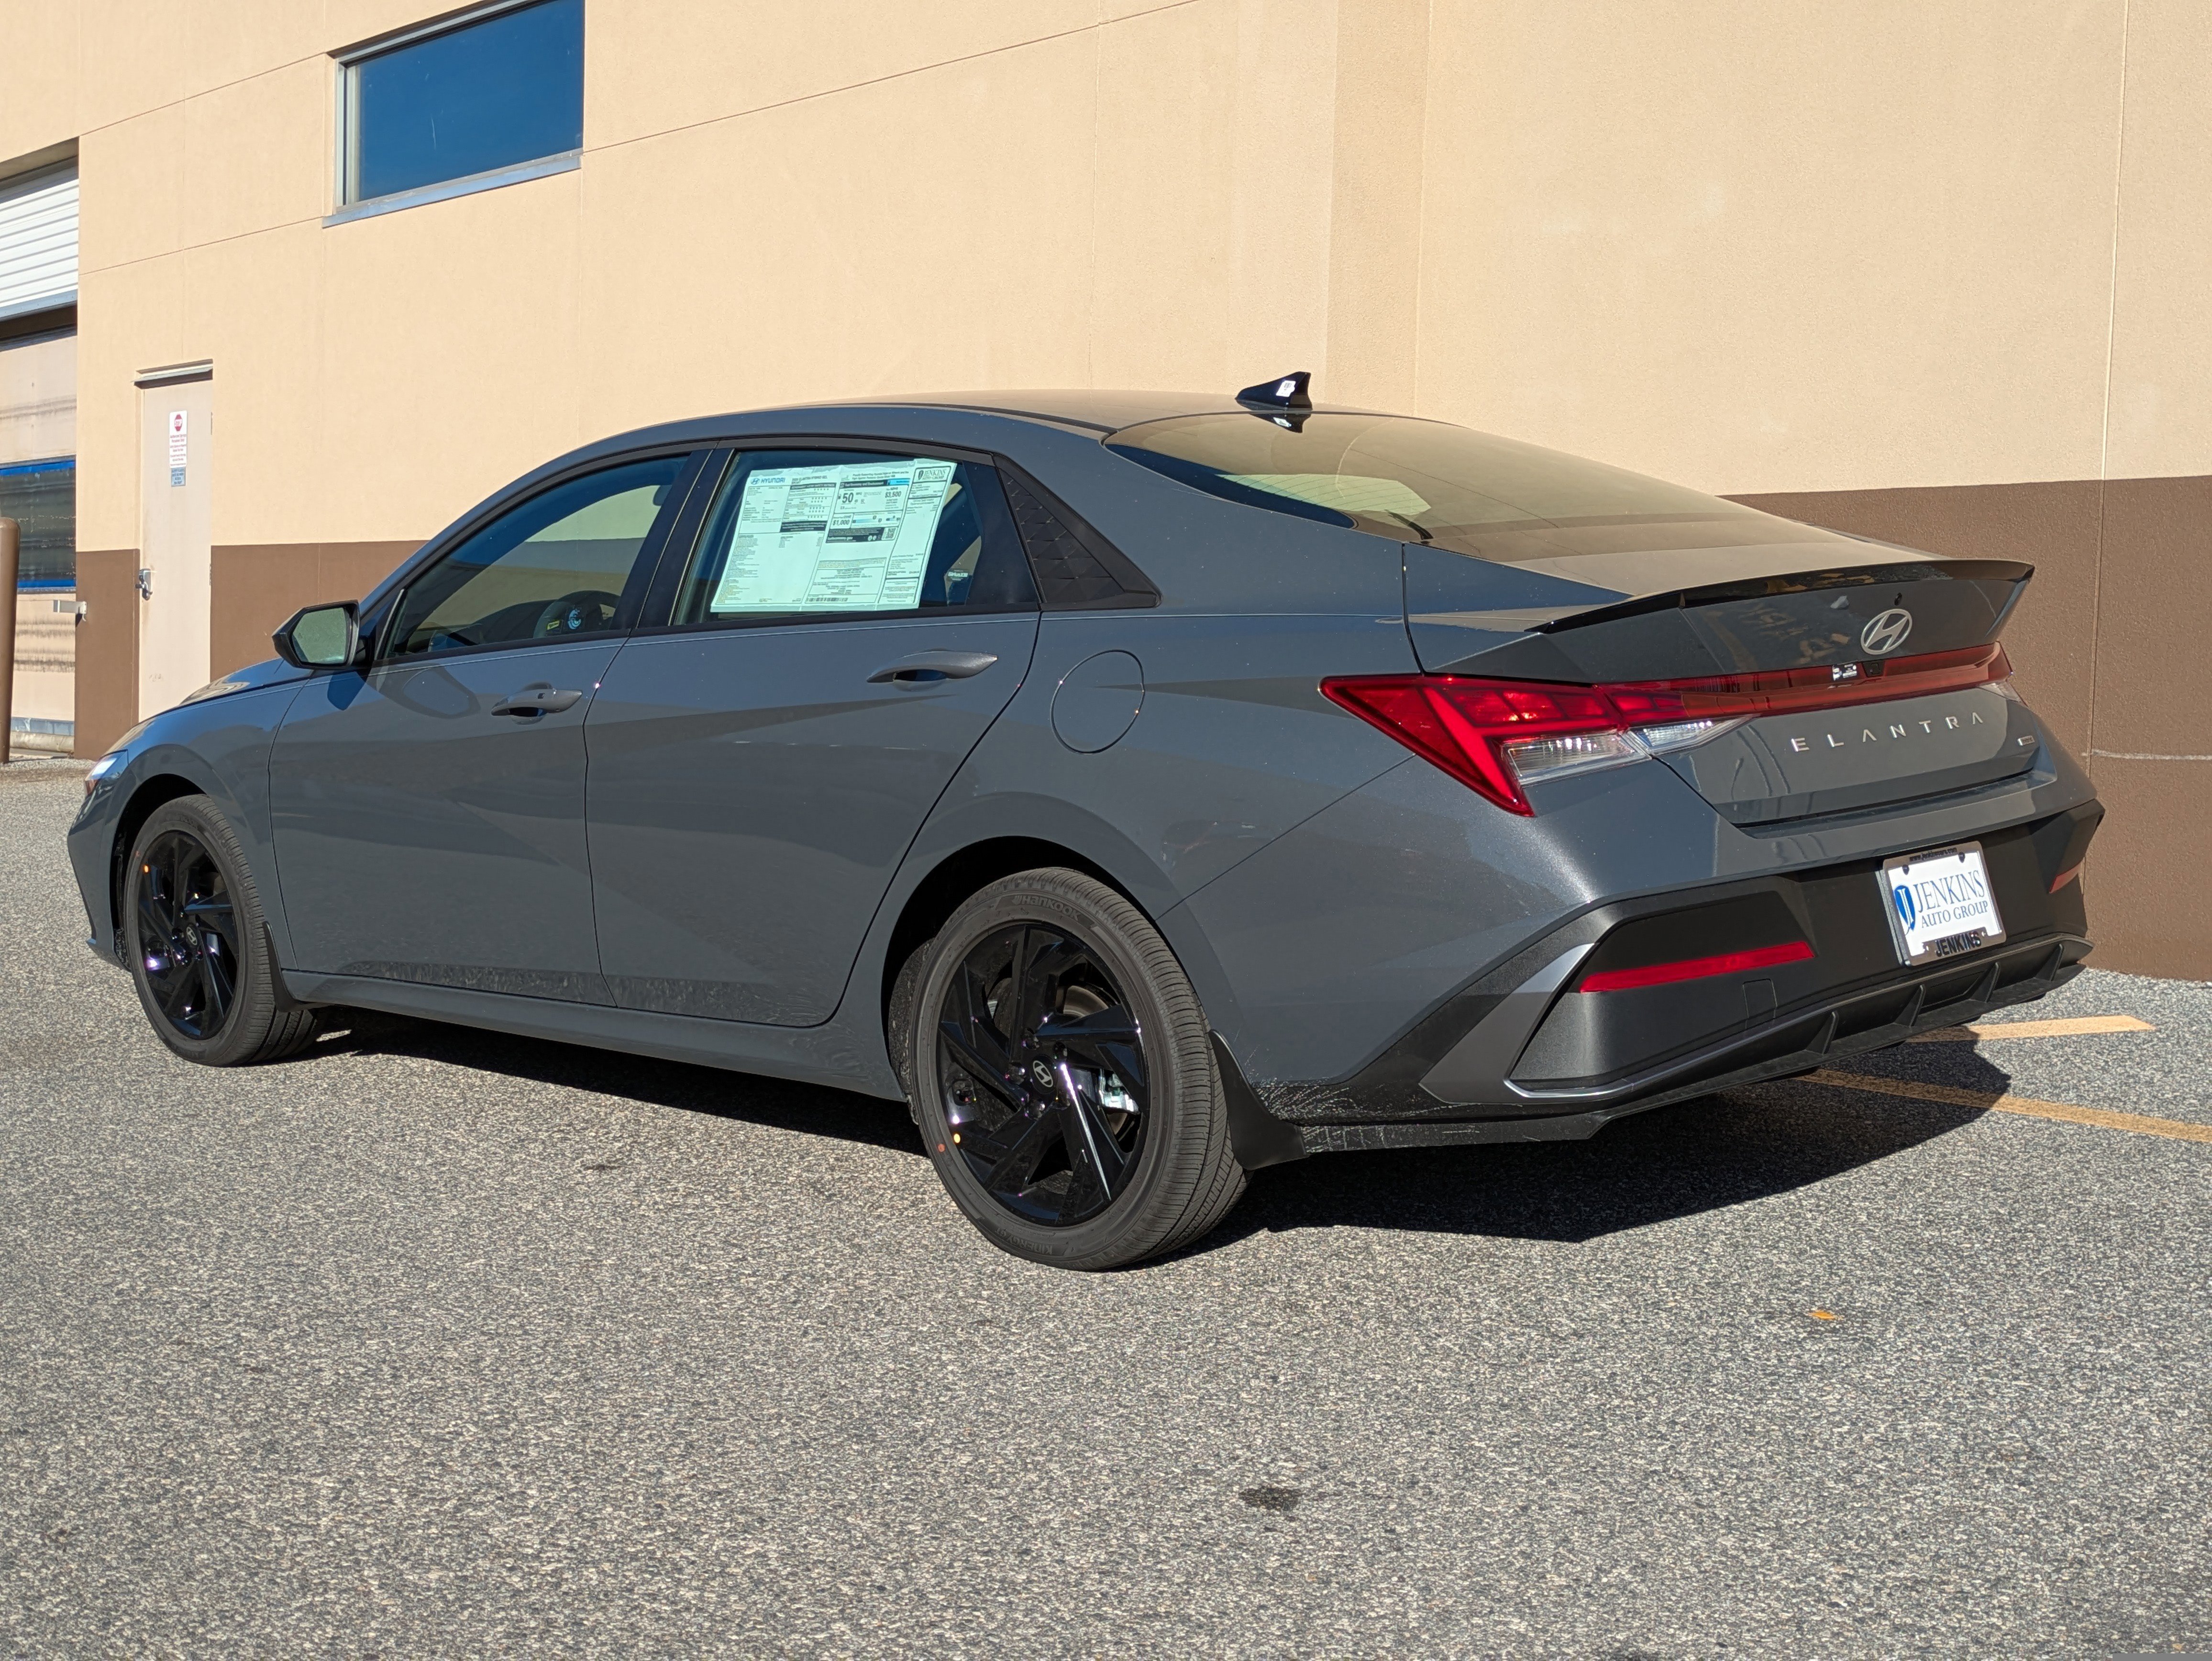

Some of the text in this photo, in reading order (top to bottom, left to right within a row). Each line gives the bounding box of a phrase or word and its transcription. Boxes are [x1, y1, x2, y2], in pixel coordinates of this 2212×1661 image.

[842, 492, 854, 503] 50
[1791, 712, 1983, 753] ELANTRA
[1913, 870, 1985, 913] JENKINS
[1921, 900, 1988, 929] AUTO GROUP
[1935, 930, 1982, 957] JENKINS
